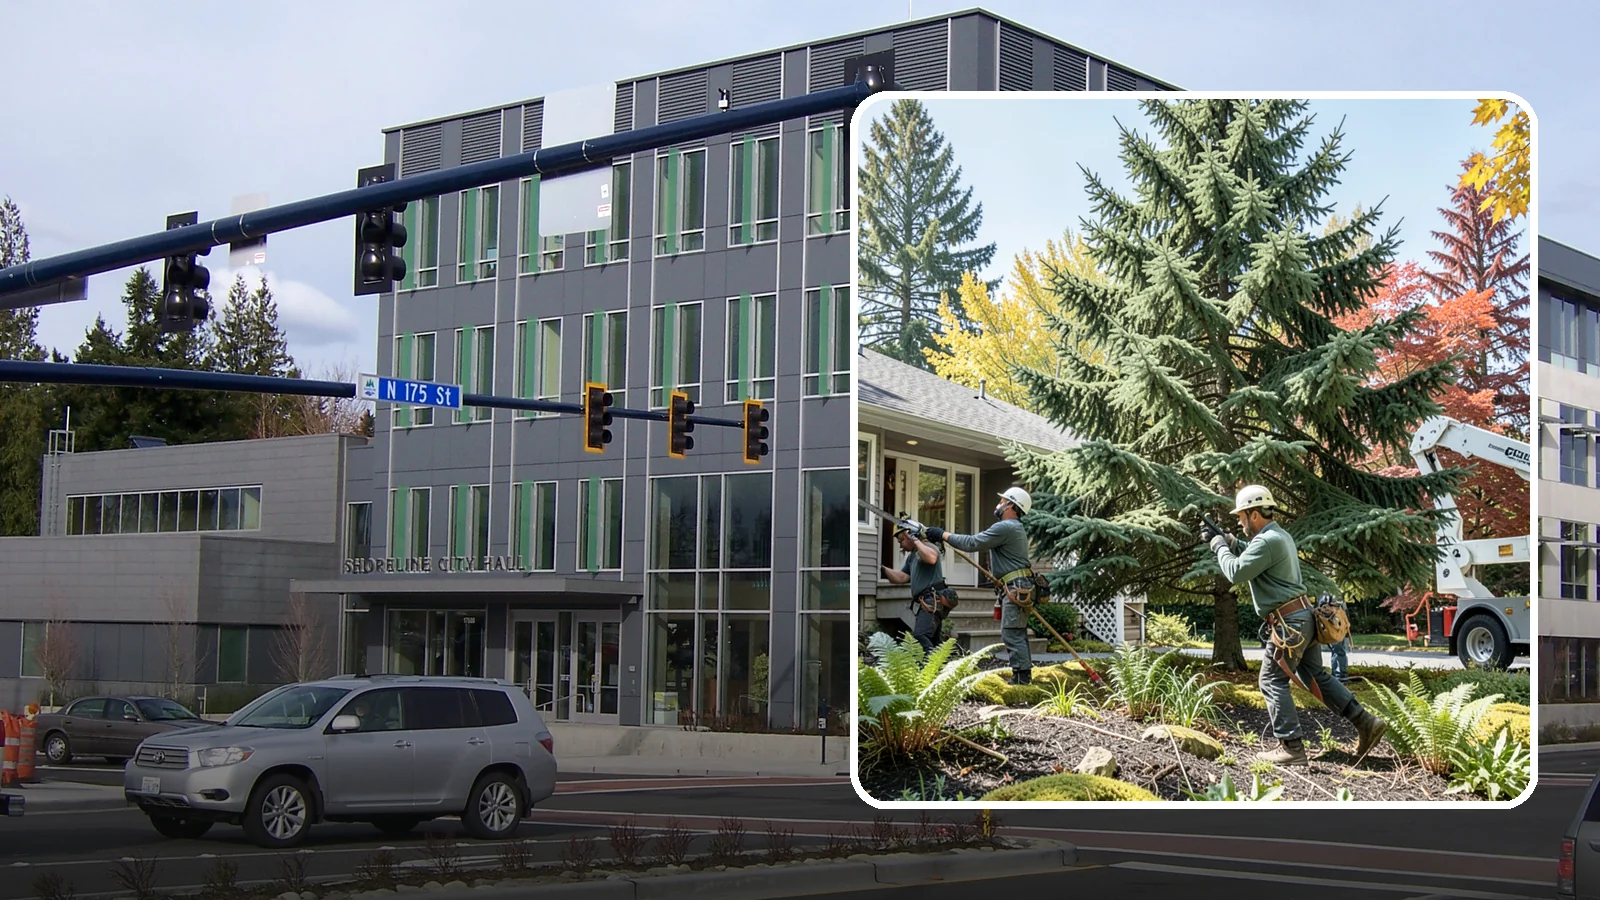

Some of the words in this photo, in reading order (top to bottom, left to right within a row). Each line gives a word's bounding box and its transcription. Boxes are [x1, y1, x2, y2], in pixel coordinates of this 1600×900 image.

[387, 381, 396, 400] N
[405, 382, 427, 403] 175
[436, 386, 451, 406] St
[343, 557, 432, 573] SHORELINE
[438, 556, 476, 572] CITY
[484, 556, 525, 571] HALL
